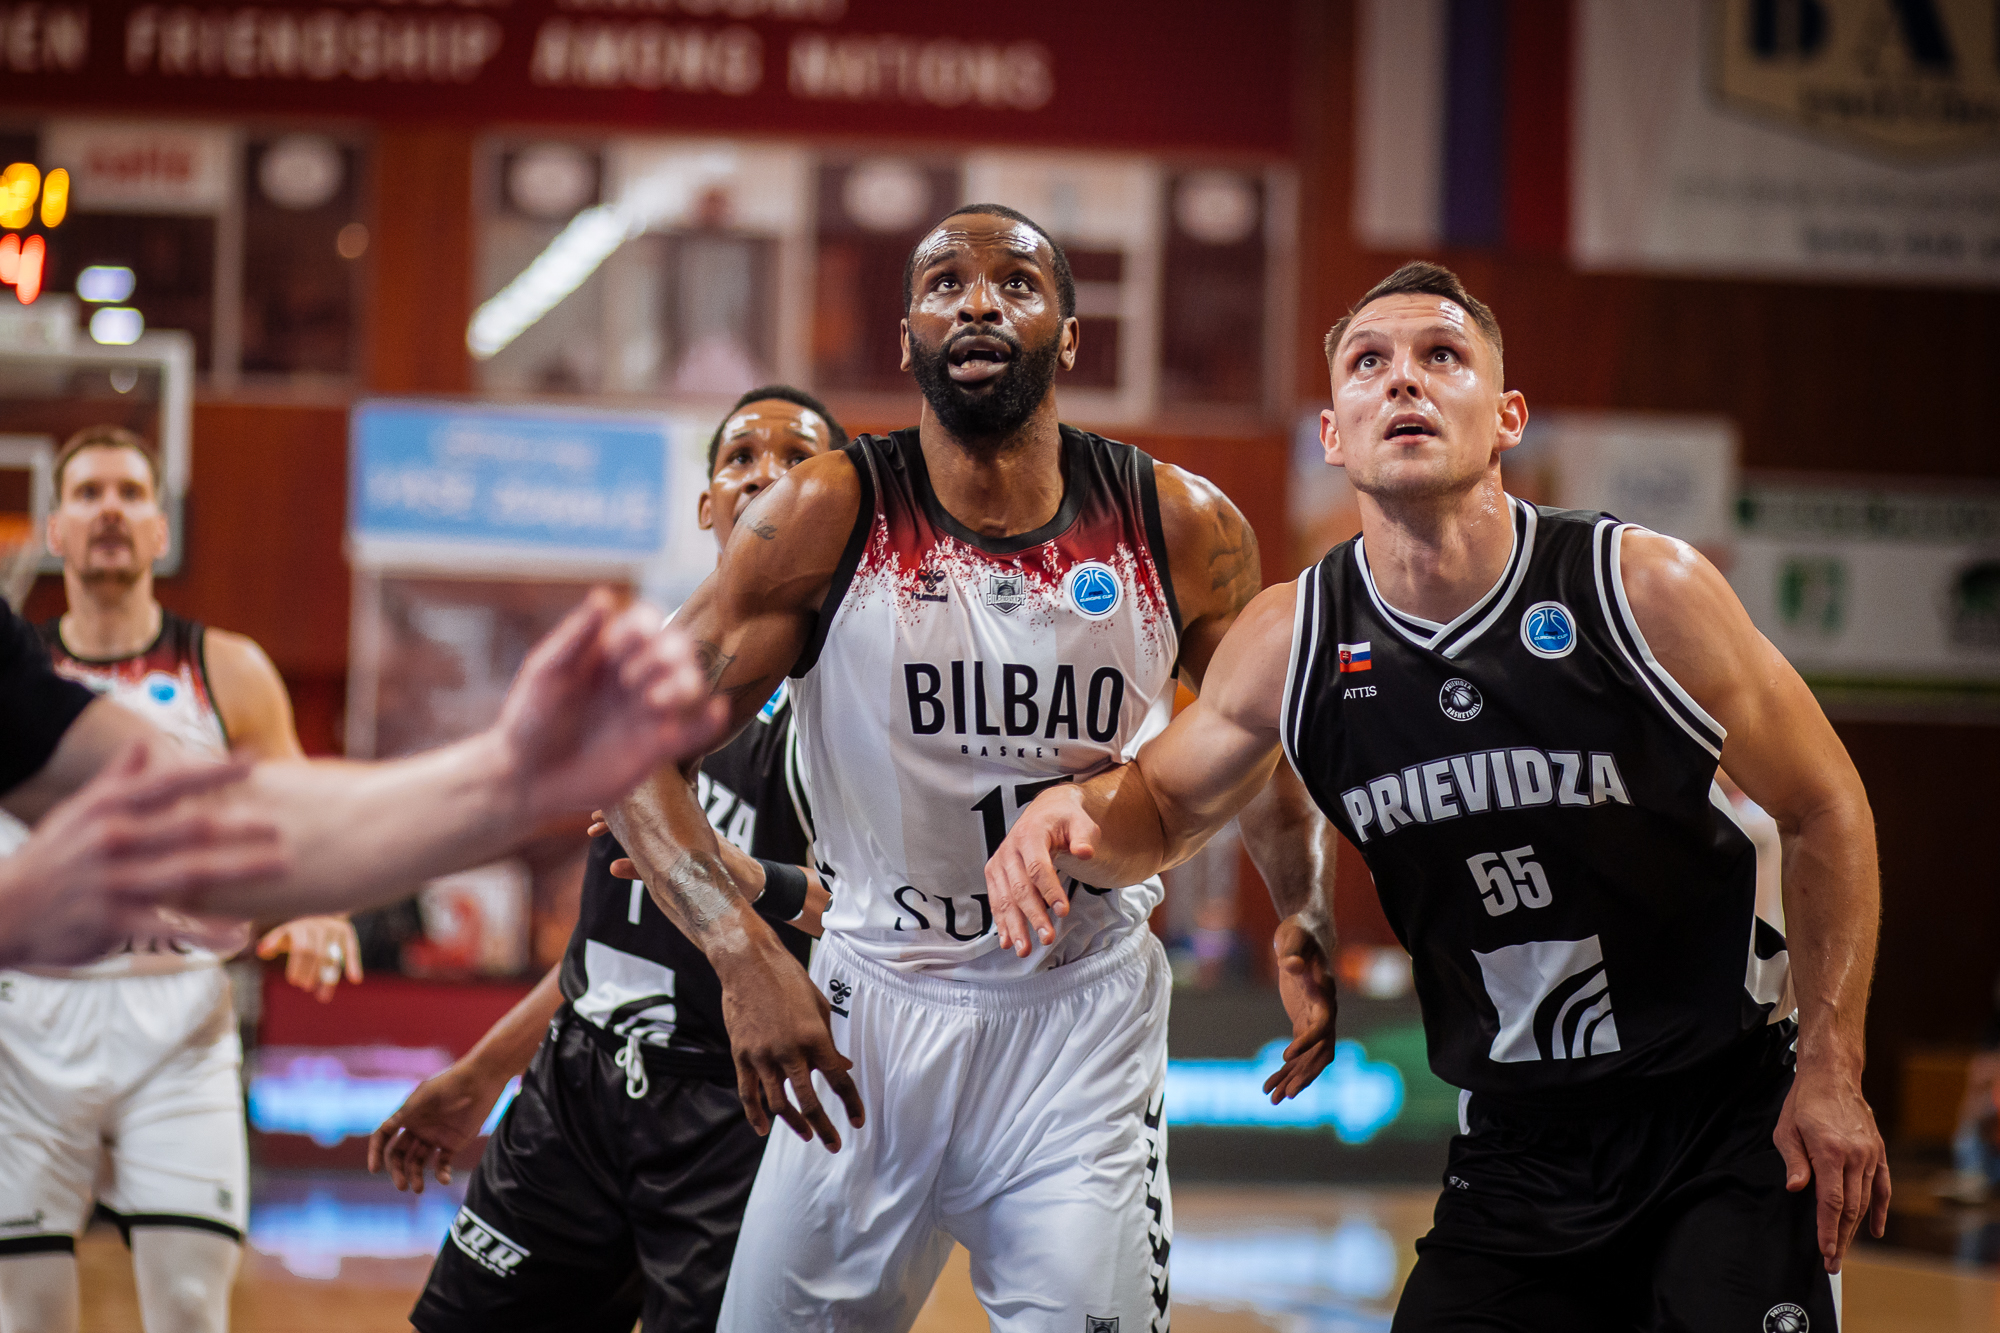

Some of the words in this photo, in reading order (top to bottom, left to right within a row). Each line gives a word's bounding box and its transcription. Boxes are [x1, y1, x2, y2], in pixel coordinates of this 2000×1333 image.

[0, 3, 90, 73] EN
[124, 6, 505, 85] FRIENDSHIP
[528, 15, 765, 95] AMONG
[788, 26, 1056, 111] NATIONS
[904, 660, 1124, 743] BILBAO
[1343, 685, 1378, 700] ATTIS
[1446, 703, 1481, 719] BASKETBALL
[961, 744, 1061, 759] BASKET
[1341, 747, 1634, 843] PRIEVIDZA
[1466, 845, 1553, 917] 55
